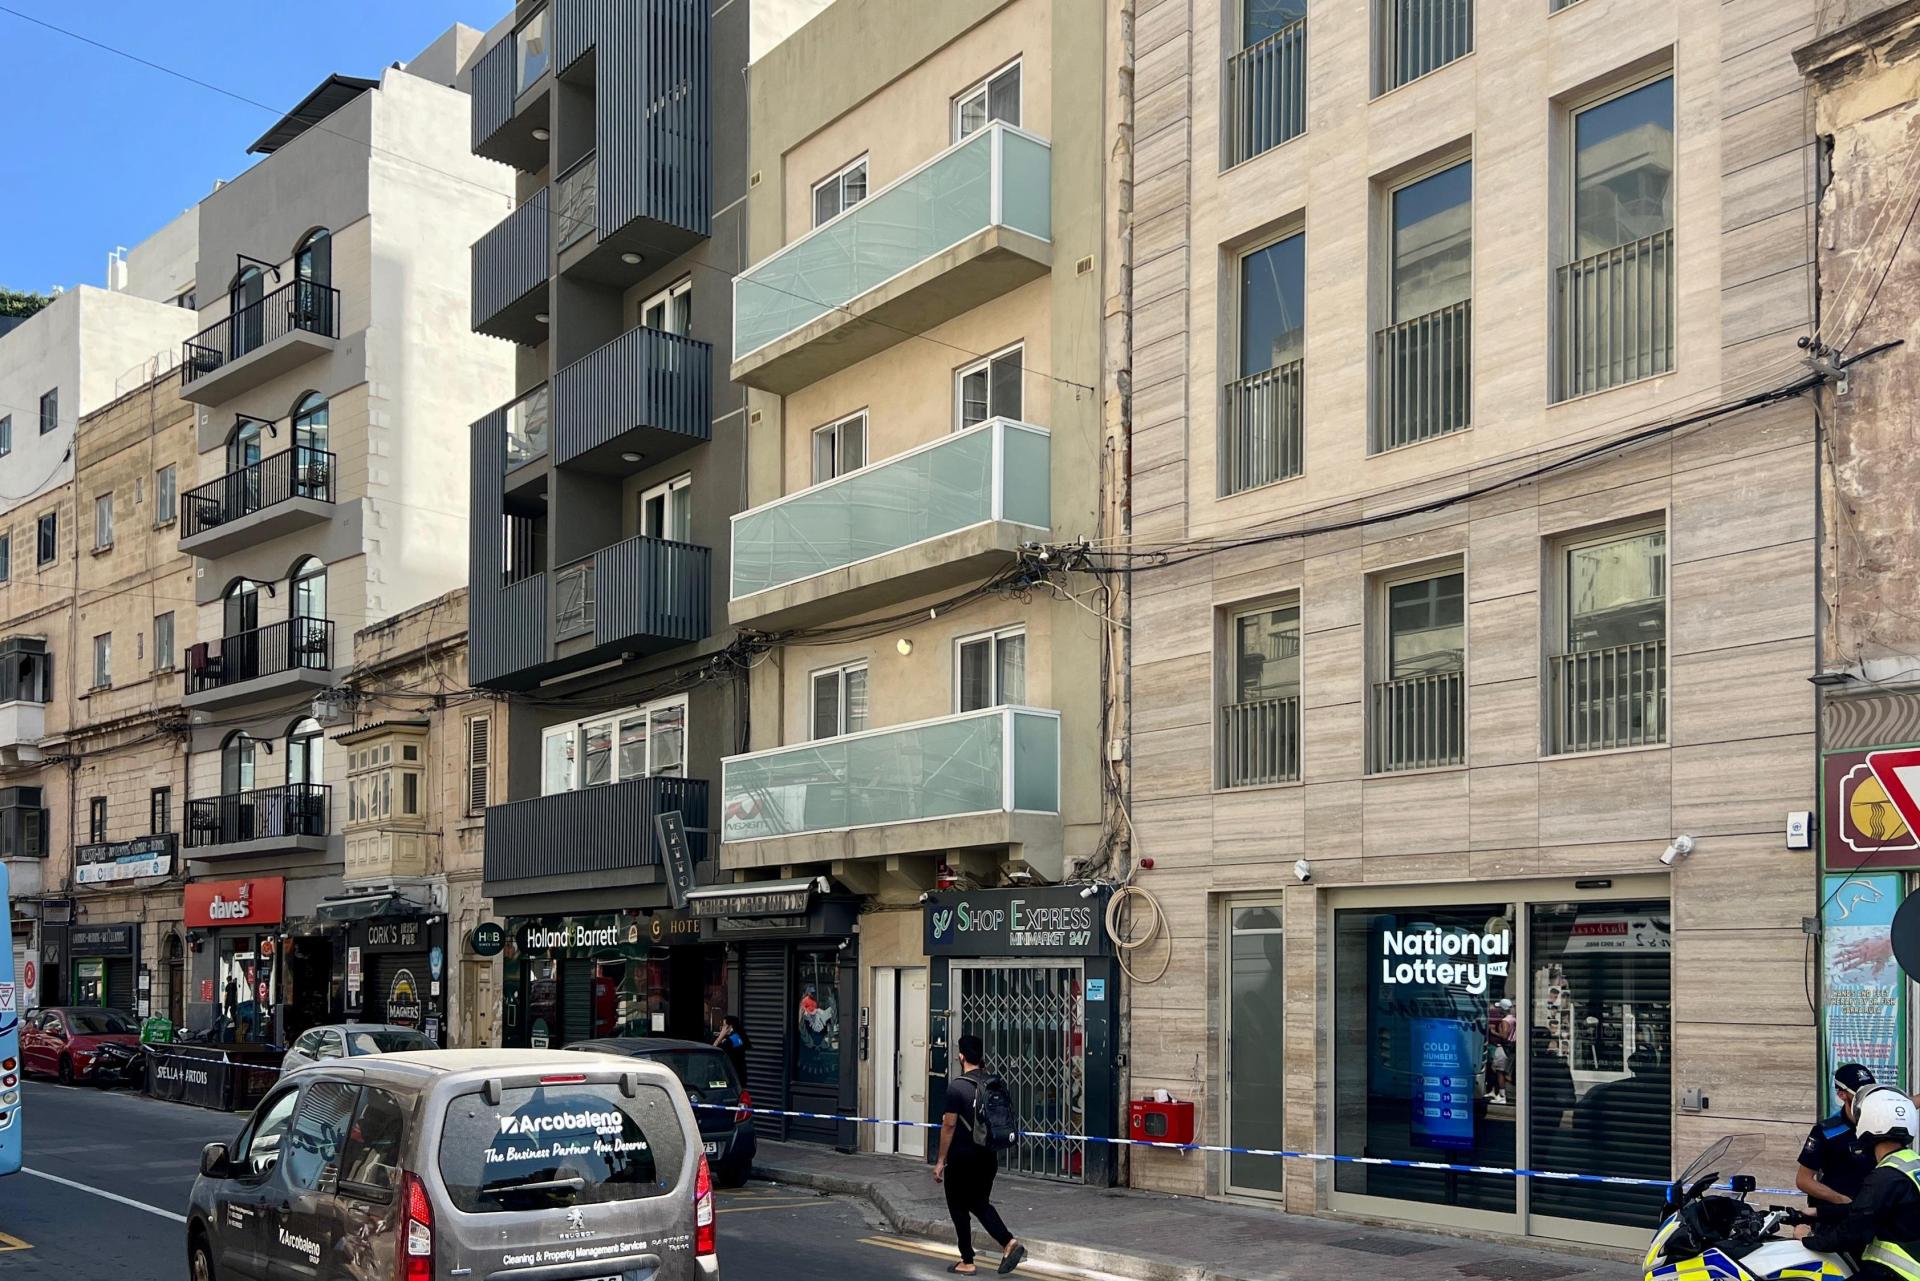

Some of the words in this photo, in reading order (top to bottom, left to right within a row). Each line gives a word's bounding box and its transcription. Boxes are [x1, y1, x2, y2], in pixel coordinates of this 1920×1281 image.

[209, 895, 250, 920] daves
[957, 901, 1005, 931] SHOP
[1010, 899, 1092, 931] EXPRESS
[368, 923, 398, 945] CORK'S
[527, 927, 568, 949] Holland
[576, 925, 618, 947] Barrett
[670, 920, 700, 934] HOTE
[401, 933, 416, 946] PUB
[1009, 931, 1065, 946] MINIMARKET
[1069, 931, 1092, 946] 24/7
[1383, 927, 1510, 956] National
[1383, 959, 1488, 995] Lottery
[389, 1005, 419, 1019] MAGNERS
[1423, 1042, 1450, 1052] COLD
[185, 1069, 208, 1085] ARTOIS
[519, 1110, 623, 1133] Arcobaleno
[596, 1126, 623, 1135] GROUP
[485, 1148, 505, 1163] The
[506, 1146, 550, 1162] Business
[552, 1142, 591, 1157] Partner
[593, 1140, 613, 1155] You
[614, 1138, 648, 1152] Deserve
[284, 1229, 321, 1257] Arcobaleno
[559, 1230, 595, 1239] PEUGEOT
[651, 1234, 690, 1246] PARTNER
[502, 1254, 535, 1266] Cleaning
[535, 1252, 543, 1262] &
[543, 1249, 576, 1264] Property
[575, 1244, 620, 1259] Management
[620, 1241, 648, 1251] Services
